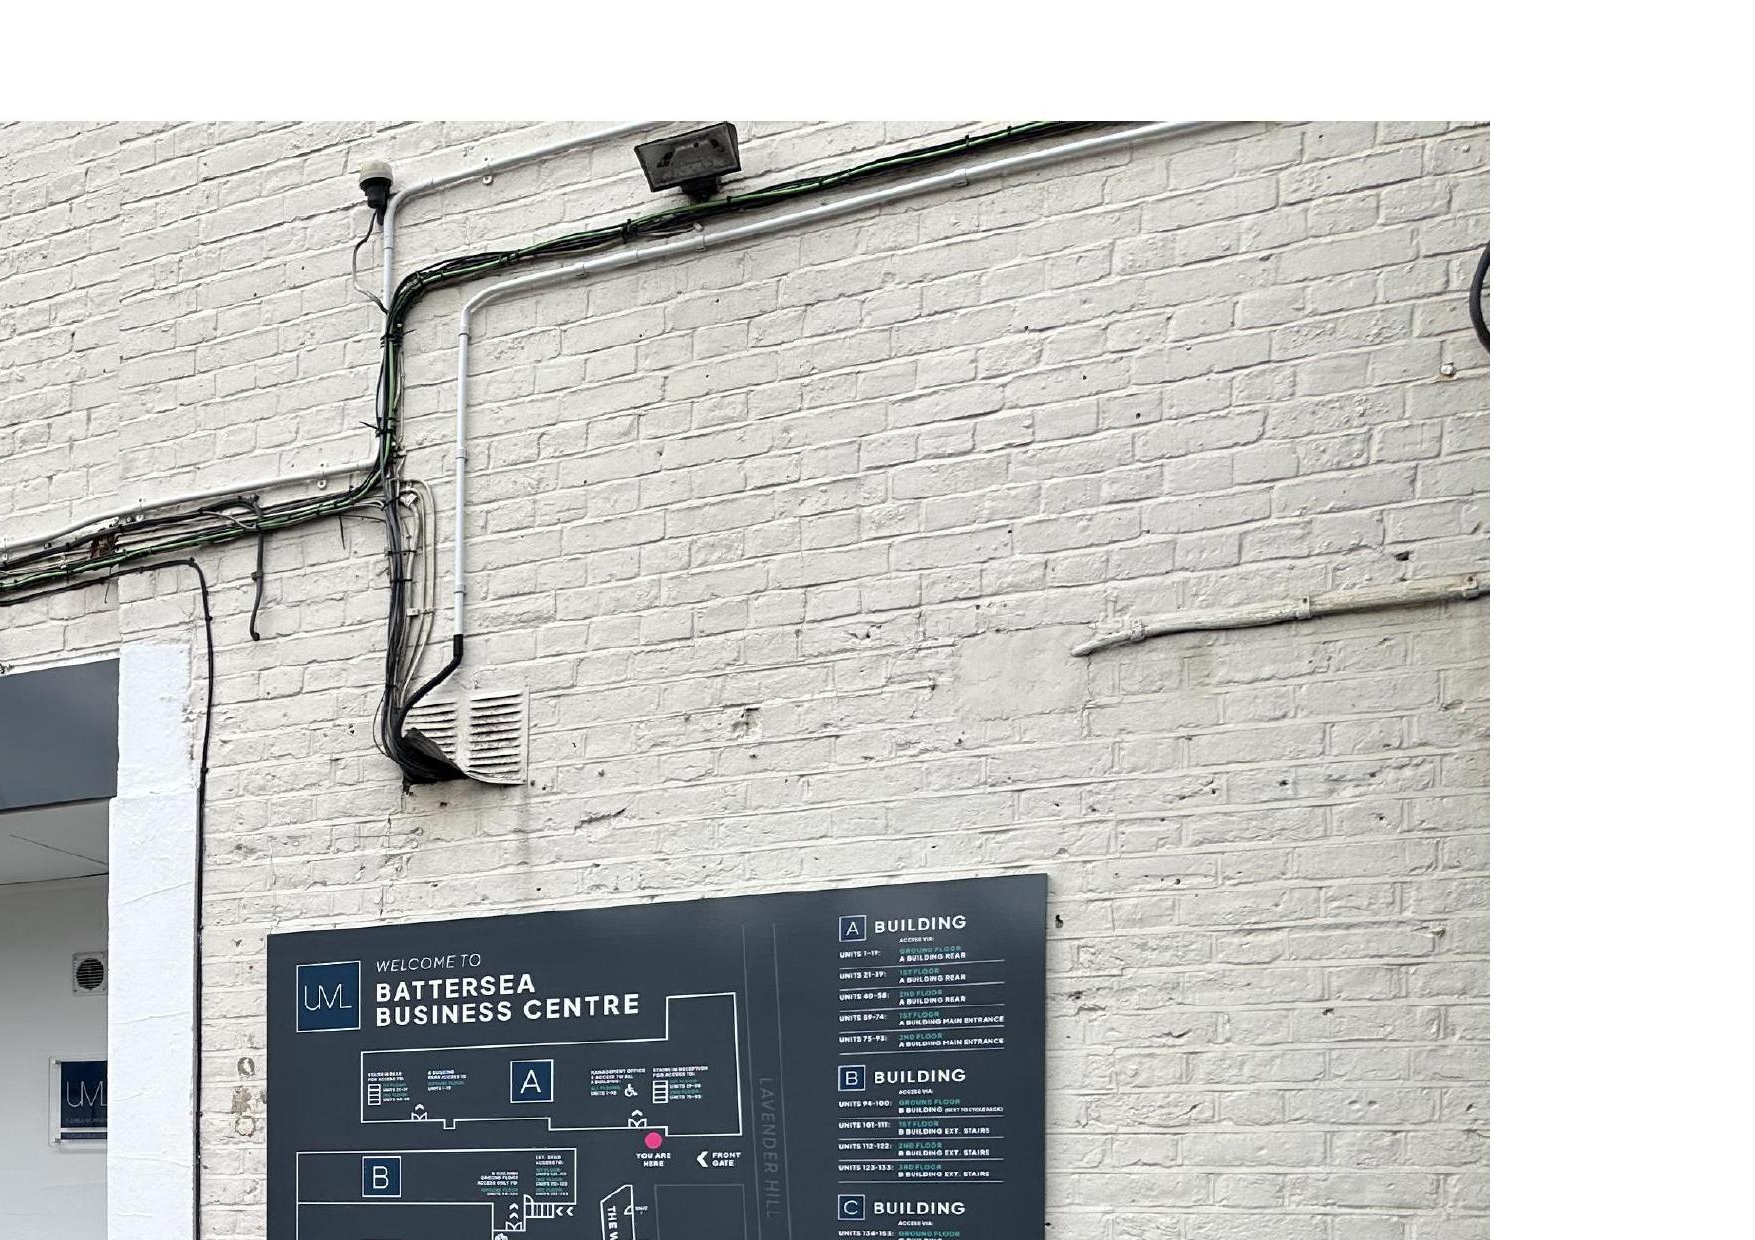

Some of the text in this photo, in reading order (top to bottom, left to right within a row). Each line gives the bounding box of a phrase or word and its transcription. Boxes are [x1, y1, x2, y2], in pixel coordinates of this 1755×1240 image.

[846, 915, 967, 936] A BUILDING
[839, 951, 862, 959] UNITS
[899, 945, 962, 955] GROUND FLOOR
[376, 953, 482, 972] WELCOME TO
[906, 954, 944, 963] BUILDING
[945, 952, 966, 961] REAR
[839, 972, 862, 980] UNITS
[913, 967, 940, 975] FLOOR
[906, 975, 944, 984] BUILDING
[945, 974, 966, 982] REAR
[376, 974, 536, 1003] BATTERSEA
[899, 989, 943, 998] 2ND FLOOR
[304, 983, 352, 1011] UML
[839, 993, 862, 1001] UNITS
[906, 997, 944, 1005] BUILDING
[945, 995, 966, 1003] REAR
[376, 993, 640, 1027] BUSINESS CENTRE
[839, 1014, 862, 1022] UNITS
[906, 1018, 942, 1026] BUILDING
[942, 1016, 963, 1025] MAIN
[964, 1015, 1005, 1024] ENTRANCE
[839, 1035, 862, 1043] UNITS
[899, 1032, 943, 1041] 2ND FLOOR
[906, 1040, 942, 1048] BUILDING
[942, 1038, 963, 1046] MAIN
[964, 1037, 1005, 1045] ENTRANCE
[519, 1069, 542, 1095] A
[845, 1068, 966, 1086] B BUILDING
[838, 1100, 862, 1108] UNITS
[933, 1098, 961, 1106] FLOOR
[838, 1121, 862, 1129] UNITS
[759, 1078, 782, 1218] LAVENDER HILL
[915, 1141, 942, 1149] FLOOR
[712, 1159, 735, 1167] GATE
[371, 1165, 390, 1189] B
[843, 1200, 966, 1215] C BUILDING
[607, 1205, 618, 1230] THE
